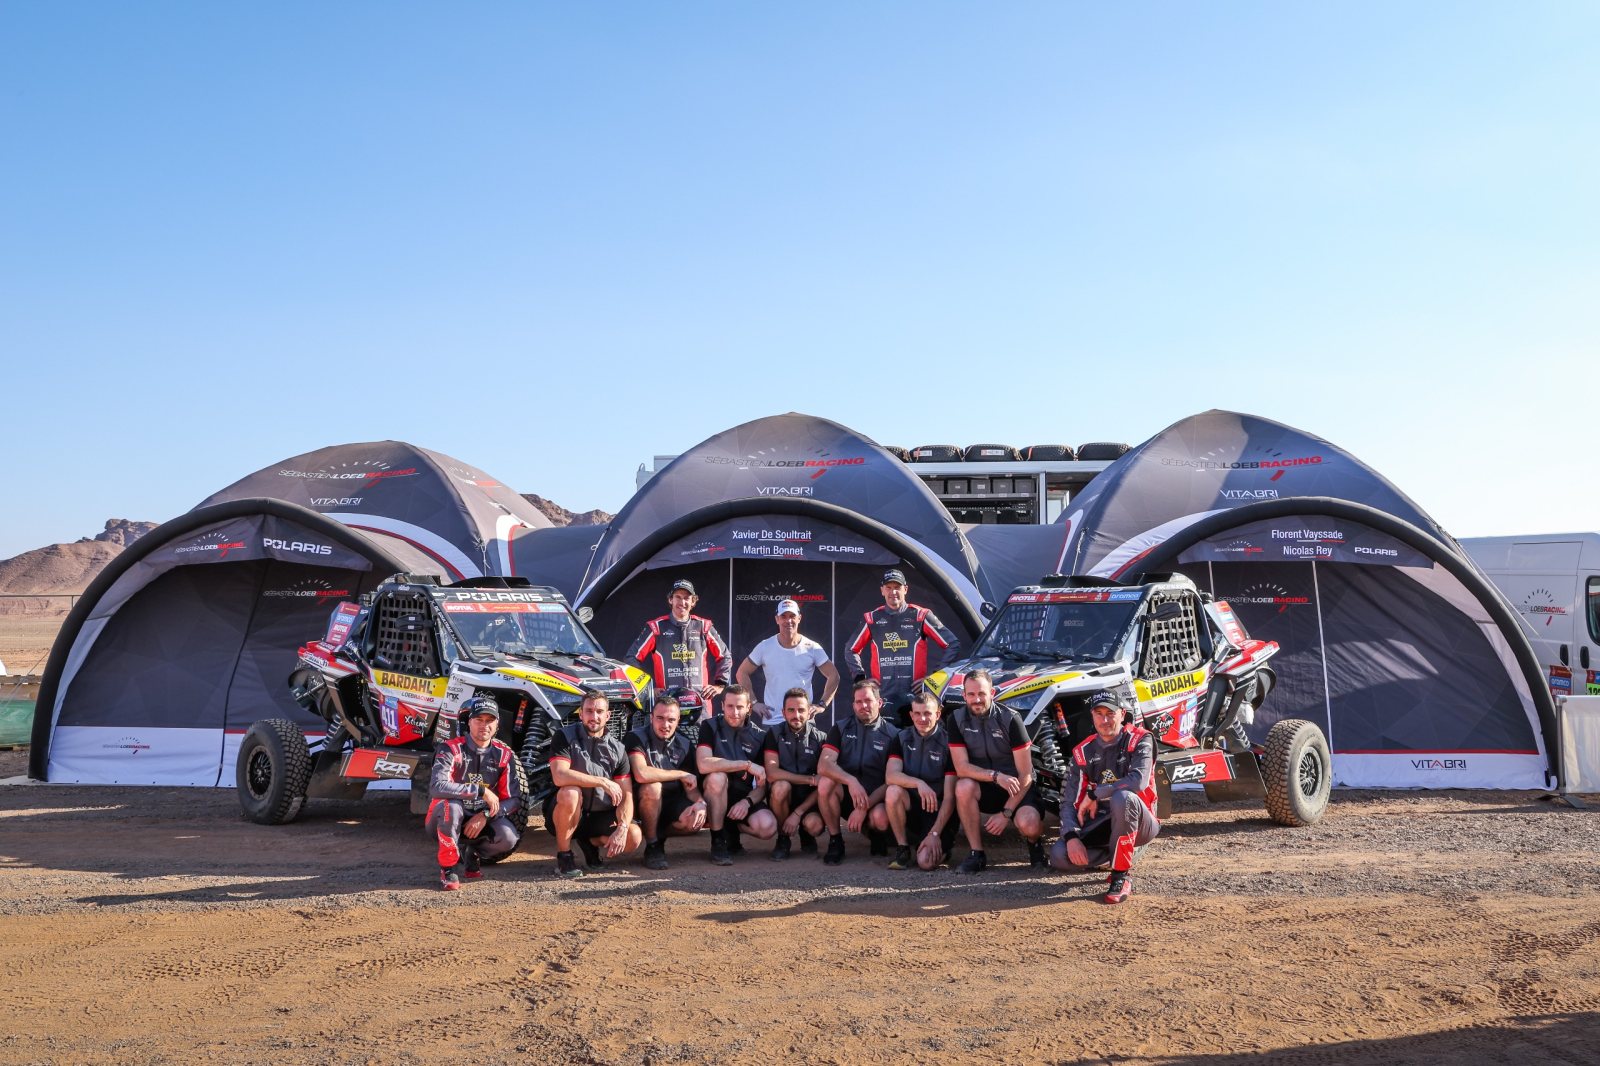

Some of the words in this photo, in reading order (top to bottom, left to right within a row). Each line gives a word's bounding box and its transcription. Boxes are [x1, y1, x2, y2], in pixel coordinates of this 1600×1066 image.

[756, 486, 814, 495] VITABRI
[1220, 489, 1279, 498] VITABRI
[310, 497, 363, 505] VITABRI
[732, 530, 759, 540] Xavier
[761, 530, 773, 539] De
[775, 529, 812, 540] Soultrait
[1271, 529, 1302, 540] Florent
[1303, 529, 1343, 541] Vayssade
[263, 537, 333, 555] POLARIS
[743, 545, 771, 555] Martin
[773, 545, 804, 556] Bonnet
[819, 545, 865, 553] POLARIS
[1283, 545, 1314, 556] Nicolas
[1316, 545, 1333, 557] Rey
[1354, 546, 1398, 556] POLARIS
[456, 592, 544, 602] POLARIS
[381, 672, 433, 694] BARDAHL
[1150, 673, 1200, 697] BARDAHL
[381, 705, 398, 730] 411
[374, 758, 411, 775] RZR
[1410, 759, 1467, 769] VITABRI
[1171, 762, 1207, 781] RZR
